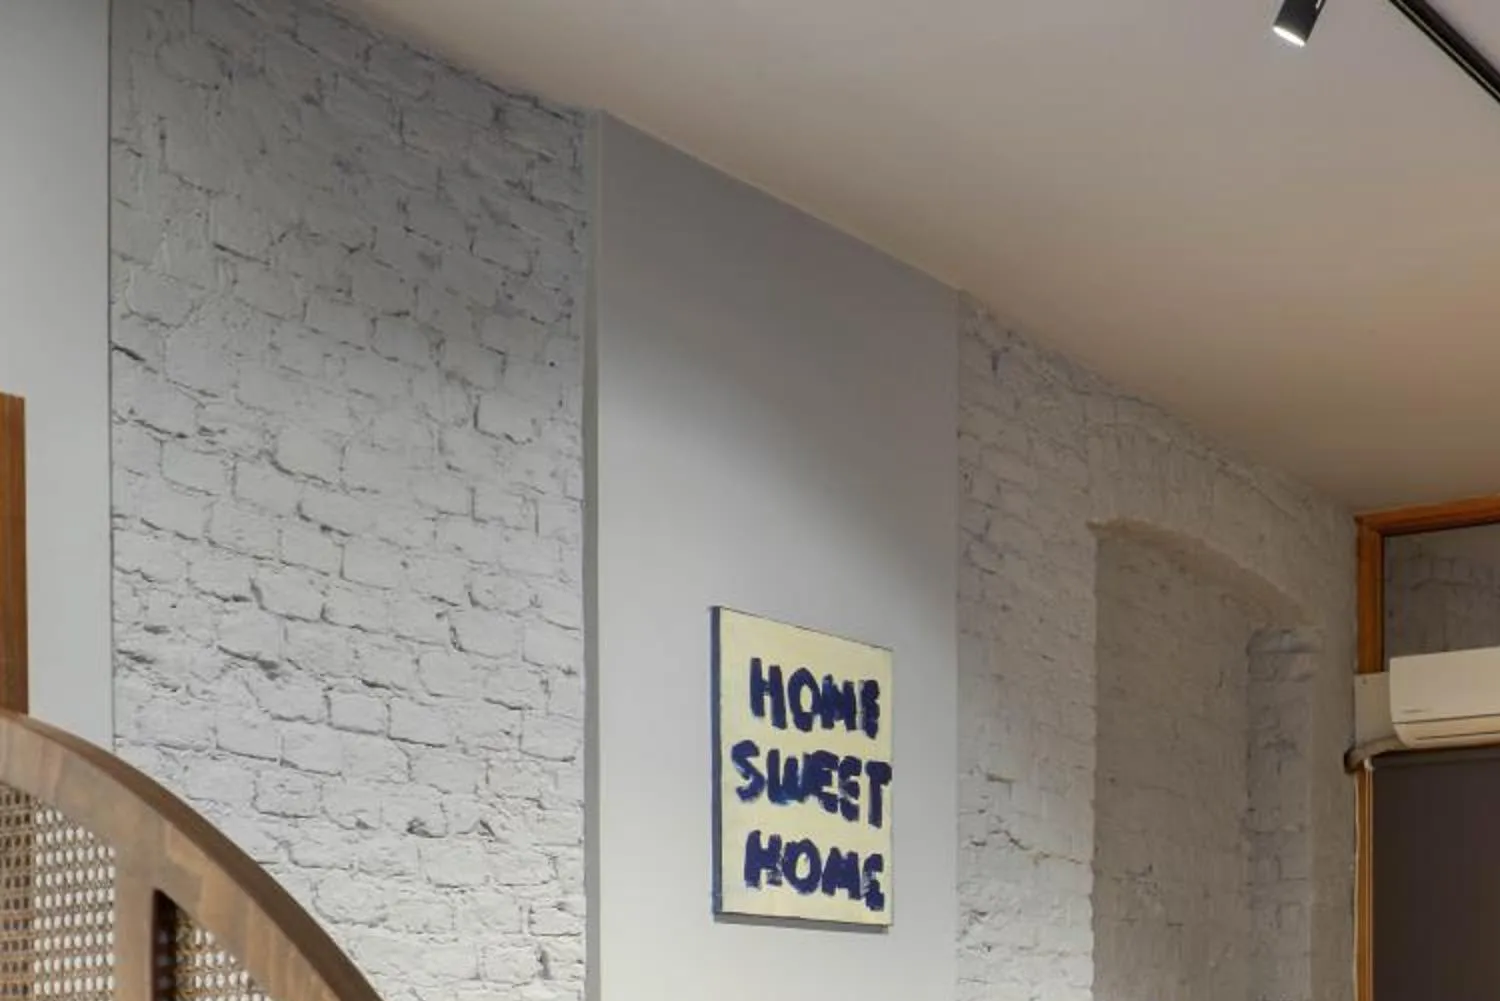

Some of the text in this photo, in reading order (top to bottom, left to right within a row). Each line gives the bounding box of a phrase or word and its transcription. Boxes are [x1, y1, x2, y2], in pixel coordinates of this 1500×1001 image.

[750, 657, 881, 739] HOME
[731, 739, 892, 828] SWEET
[744, 829, 885, 911] HOME
